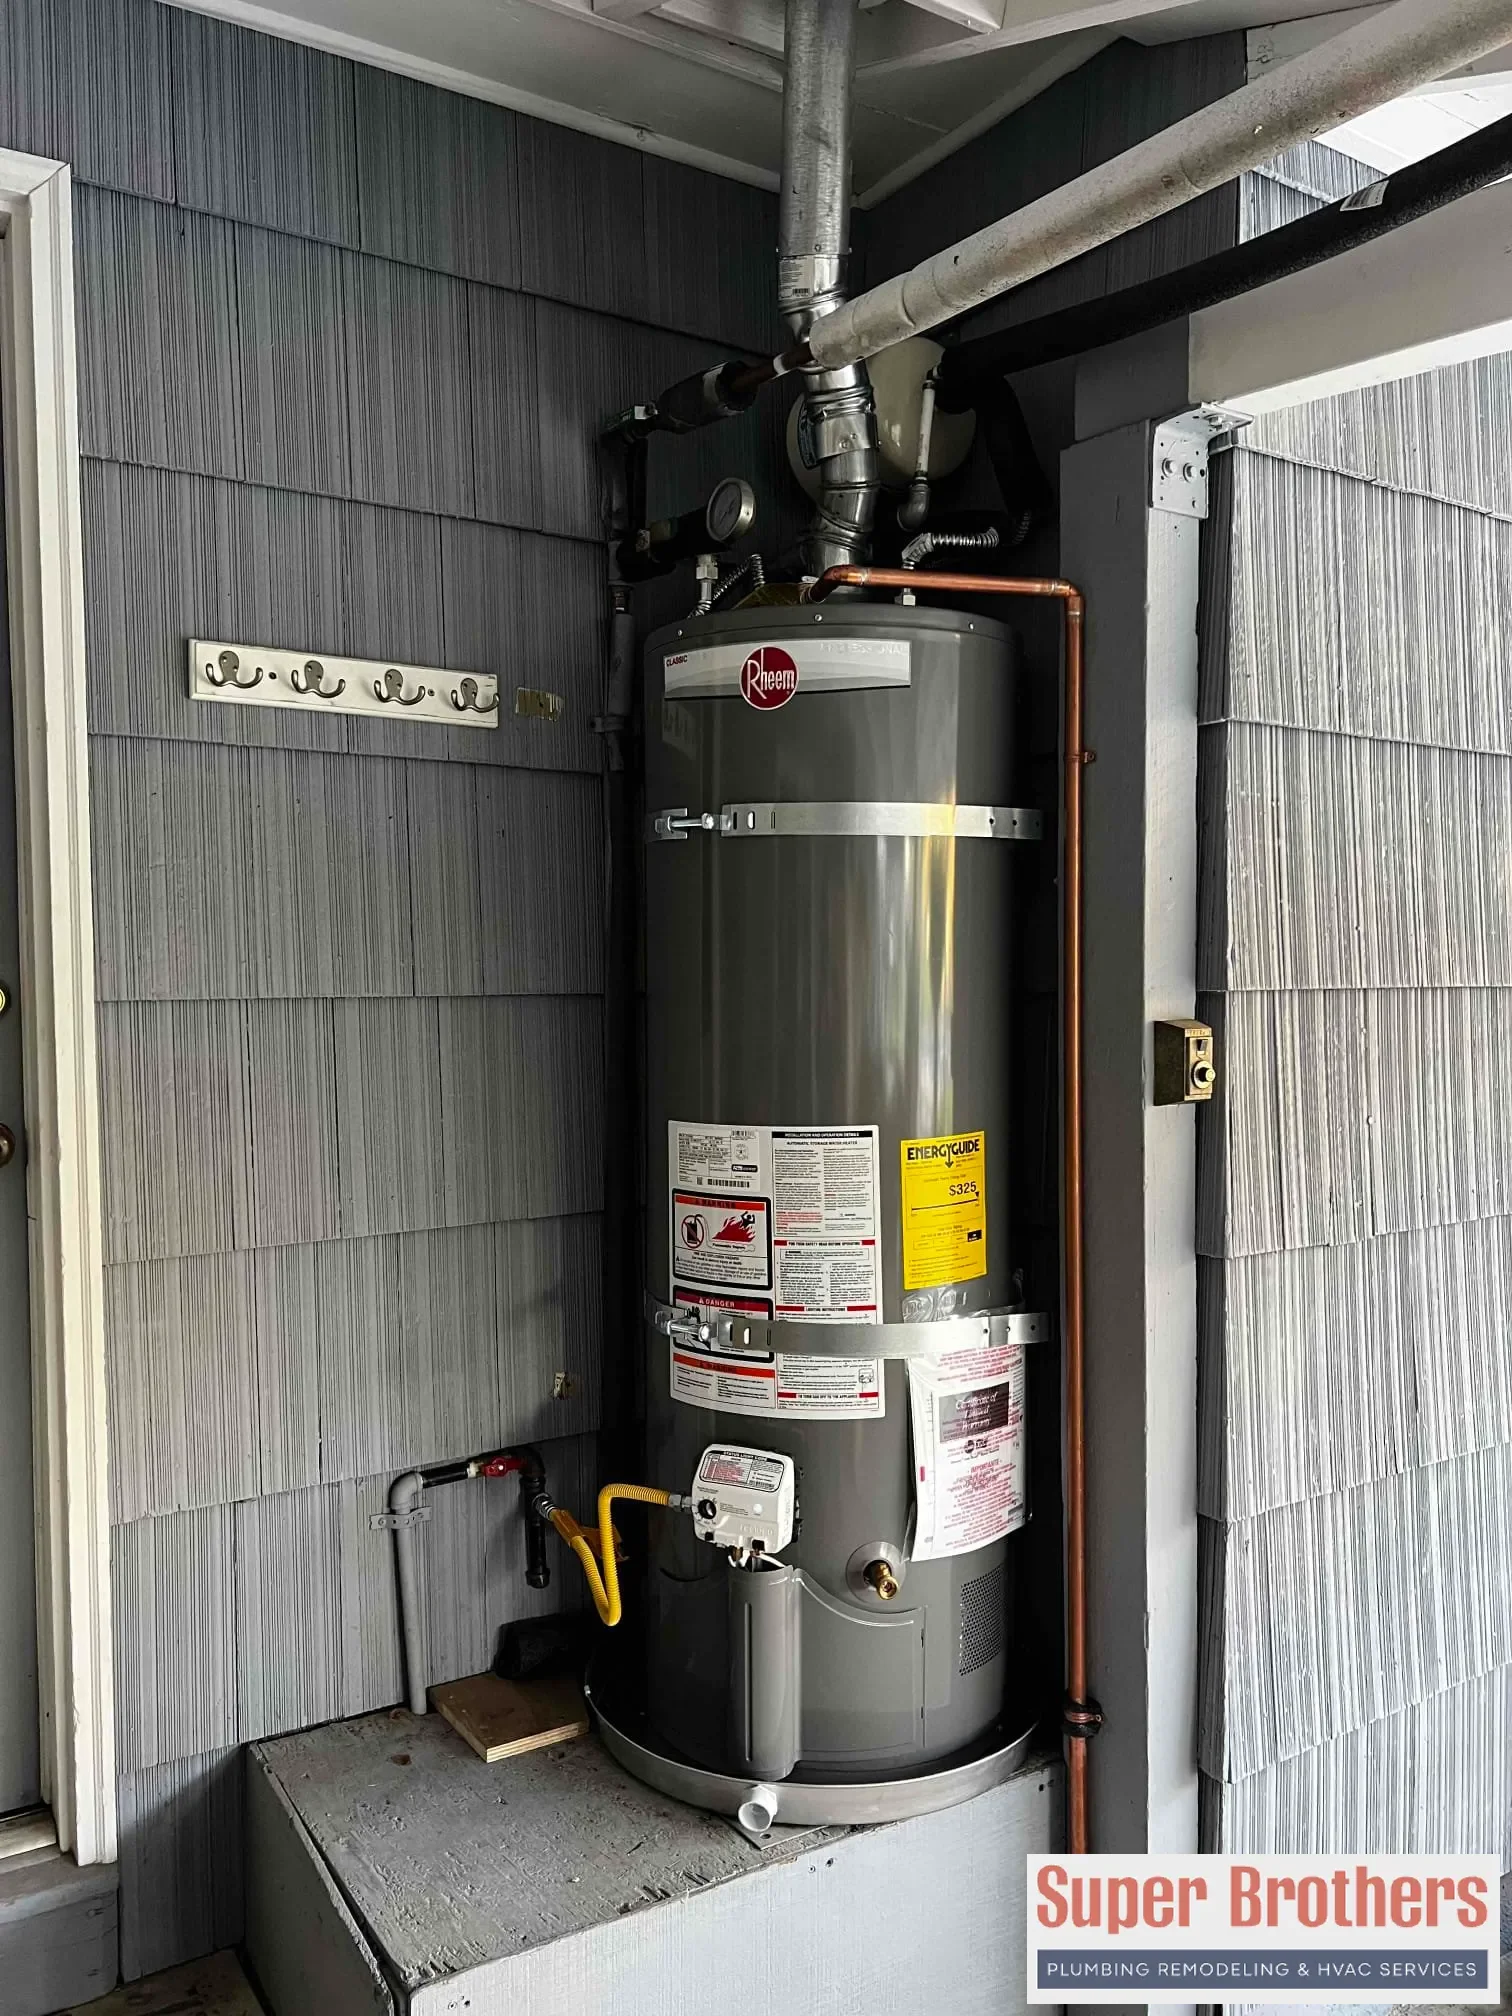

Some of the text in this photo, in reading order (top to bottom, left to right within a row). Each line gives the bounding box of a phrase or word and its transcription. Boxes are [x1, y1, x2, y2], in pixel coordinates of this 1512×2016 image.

[666, 655, 688, 667] CLASSIC
[747, 648, 795, 699] Rheem
[907, 1138, 980, 1161] ENERGYGUIDE
[705, 1298, 735, 1308] DANGER
